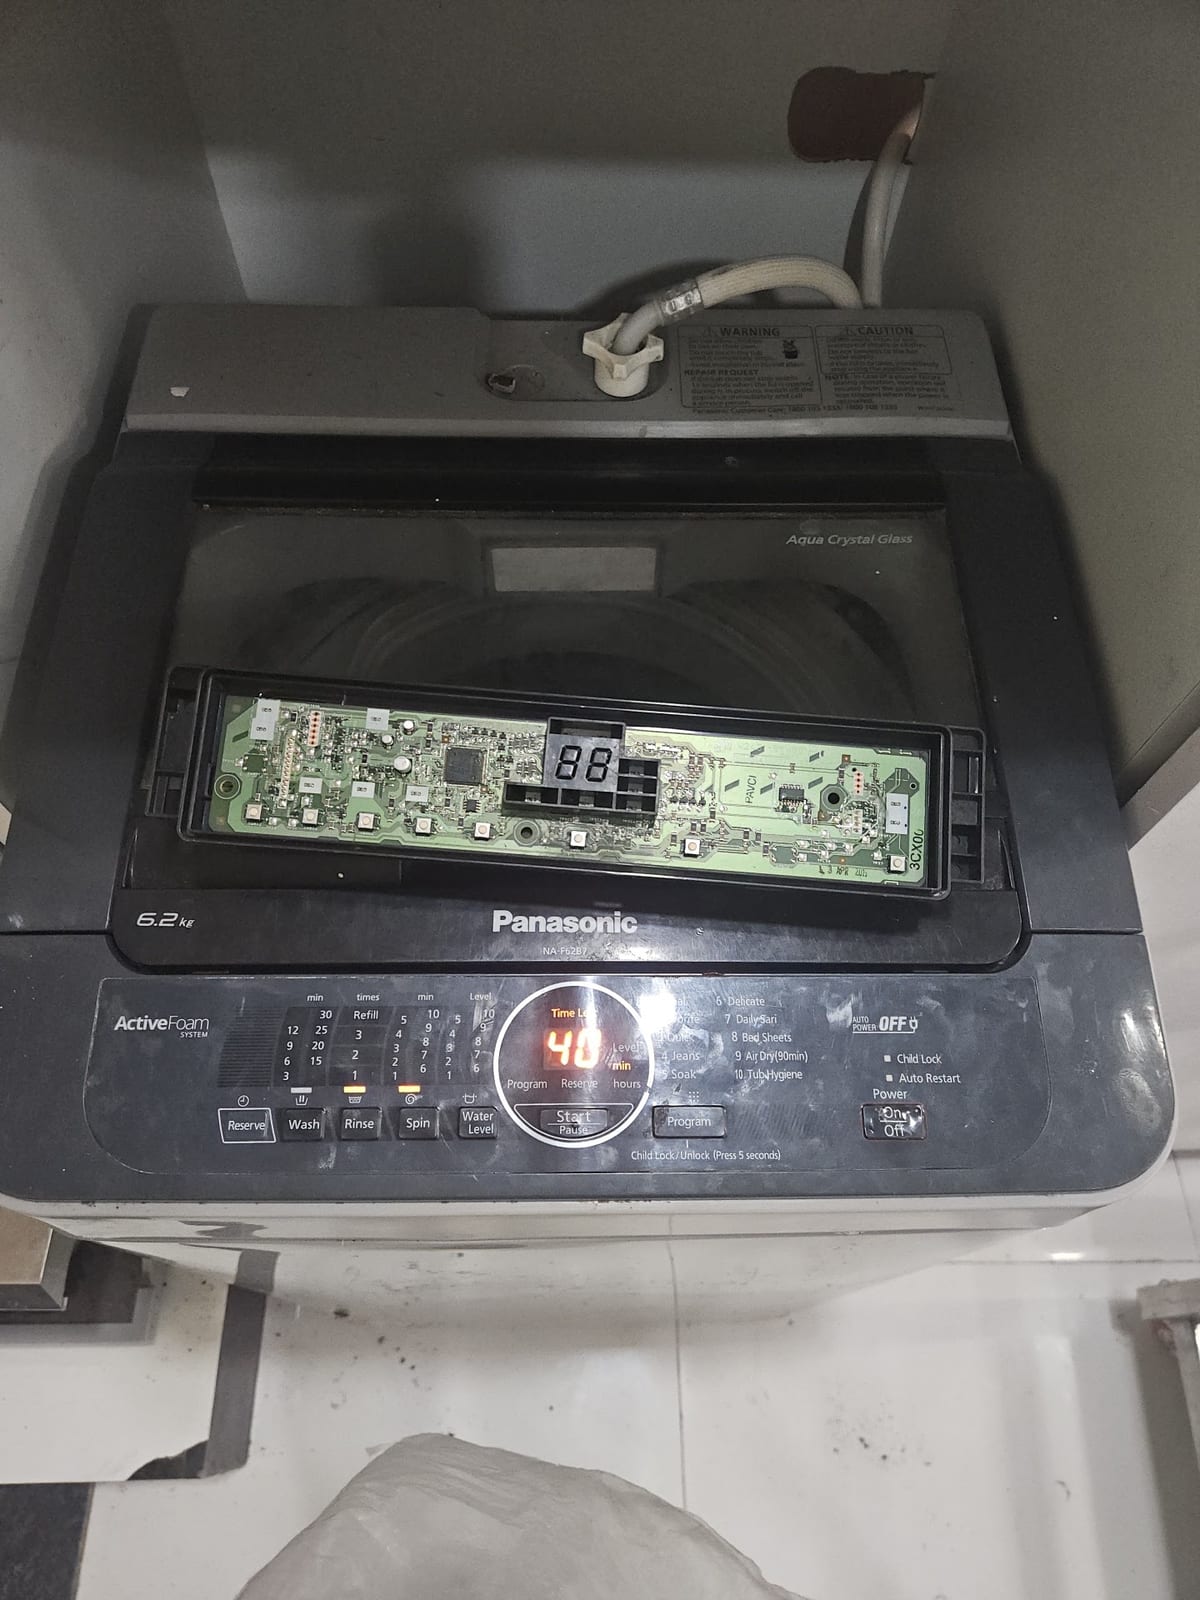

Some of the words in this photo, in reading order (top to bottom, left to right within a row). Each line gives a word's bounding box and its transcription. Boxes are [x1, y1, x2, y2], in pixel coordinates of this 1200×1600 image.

[720, 327, 780, 337] WARNING
[858, 326, 913, 336] CAUTION
[785, 535, 824, 547] Aqua
[827, 534, 875, 547] Crystal
[877, 533, 913, 544] Glass
[745, 775, 757, 804] PAVCI
[492, 909, 638, 933] Panasonic
[542, 946, 587, 956] NA-F62B7
[307, 993, 324, 1002] min
[356, 993, 380, 1001] times
[417, 993, 434, 1001] min
[469, 992, 492, 1001] Level
[716, 997, 722, 1006] 6
[728, 997, 765, 1006] Delicate
[319, 1010, 333, 1019] 30
[353, 1010, 379, 1020] Refill
[428, 1009, 440, 1019] 10
[483, 1009, 495, 1018] 10
[551, 1008, 575, 1018] Time
[401, 1015, 407, 1024] 5
[455, 1015, 461, 1024] 5
[725, 1014, 730, 1024] 7
[736, 1014, 758, 1025] Daily
[759, 1014, 777, 1024] Sari
[879, 1016, 907, 1031] OFF
[287, 1025, 299, 1035] 12
[315, 1025, 328, 1035] 25
[425, 1023, 432, 1033] 9
[480, 1023, 487, 1032] 9
[355, 1030, 362, 1040] 3
[395, 1029, 402, 1038] 4
[449, 1029, 456, 1038] 4
[732, 1032, 738, 1042] 8
[742, 1032, 759, 1042] Bed
[762, 1033, 792, 1042] Sheets
[286, 1041, 293, 1051] 9
[311, 1041, 325, 1050] 20
[422, 1037, 430, 1047] 8
[475, 1037, 482, 1046] 8
[393, 1043, 400, 1053] 3
[612, 1042, 639, 1052] Level
[352, 1050, 359, 1060] 2
[421, 1050, 428, 1060] 7
[474, 1050, 481, 1059] 7
[661, 1051, 667, 1060] 4
[672, 1052, 700, 1061] Jeans
[735, 1051, 742, 1061] 9
[760, 1051, 808, 1063] Dry(90min)
[896, 1054, 918, 1064] Child
[921, 1054, 942, 1064] Lock
[284, 1056, 291, 1066] 6
[310, 1056, 322, 1066] 15
[392, 1057, 399, 1067] 2
[445, 1056, 452, 1066] 2
[612, 1061, 631, 1071] min
[420, 1064, 427, 1073] 6
[473, 1063, 480, 1073] 6
[283, 1071, 289, 1081] 3
[352, 1070, 357, 1081] 1
[393, 1071, 397, 1081] 1
[447, 1071, 451, 1080] 1
[672, 1069, 697, 1079] Soak
[735, 1069, 743, 1079] 10
[748, 1070, 764, 1079] Tub
[766, 1070, 803, 1081] Hygiene
[899, 1074, 923, 1083] Auto
[926, 1074, 961, 1084] Restart
[507, 1079, 548, 1091] Program
[561, 1079, 598, 1088] Reserve
[613, 1079, 641, 1089] hours
[873, 1089, 908, 1099] Power
[462, 1111, 494, 1121] Water
[556, 1111, 591, 1123] Start
[884, 1106, 901, 1118] On
[228, 1120, 265, 1131] Reserve
[288, 1119, 320, 1130] Wash
[344, 1118, 374, 1129] Rinse
[406, 1118, 430, 1131] Spin
[667, 1117, 712, 1128] Program
[468, 1124, 494, 1135] Level
[559, 1126, 588, 1135] Pause
[884, 1124, 905, 1137] Off
[631, 1151, 652, 1160] Child
[713, 1150, 737, 1161] (Press
[739, 1151, 744, 1160] 5
[746, 1150, 781, 1161] seconds)
